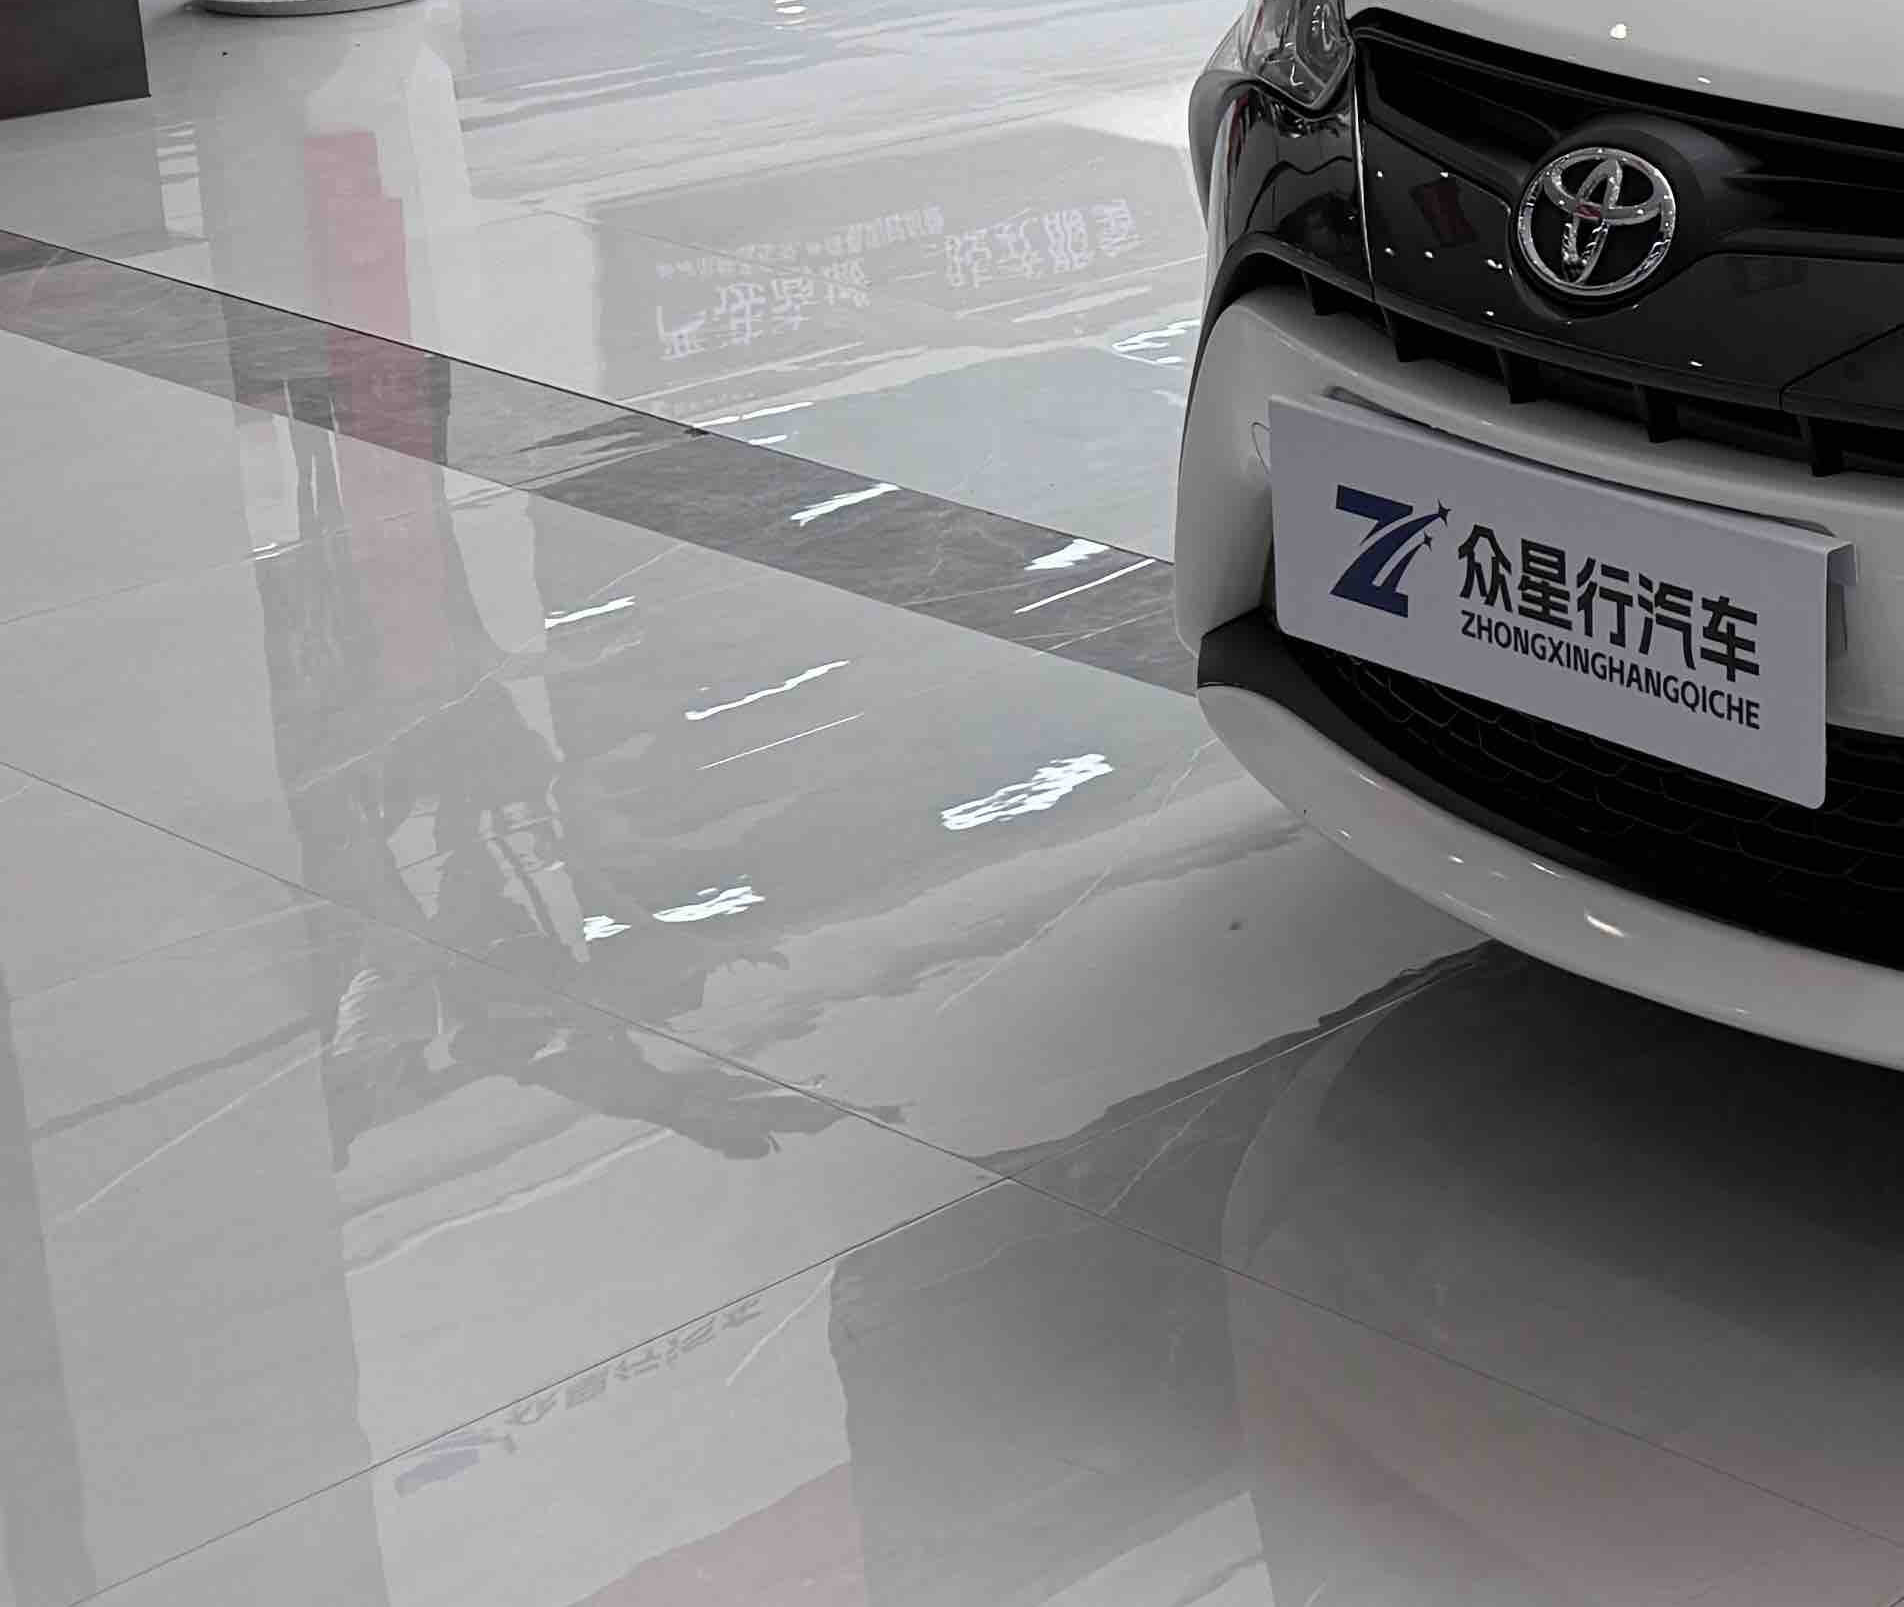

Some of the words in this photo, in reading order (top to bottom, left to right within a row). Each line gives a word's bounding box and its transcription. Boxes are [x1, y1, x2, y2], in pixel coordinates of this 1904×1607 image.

[1458, 524, 1761, 683] 众星行汽车
[1460, 609, 1762, 731] ZHONGXINGHANGQICHE
